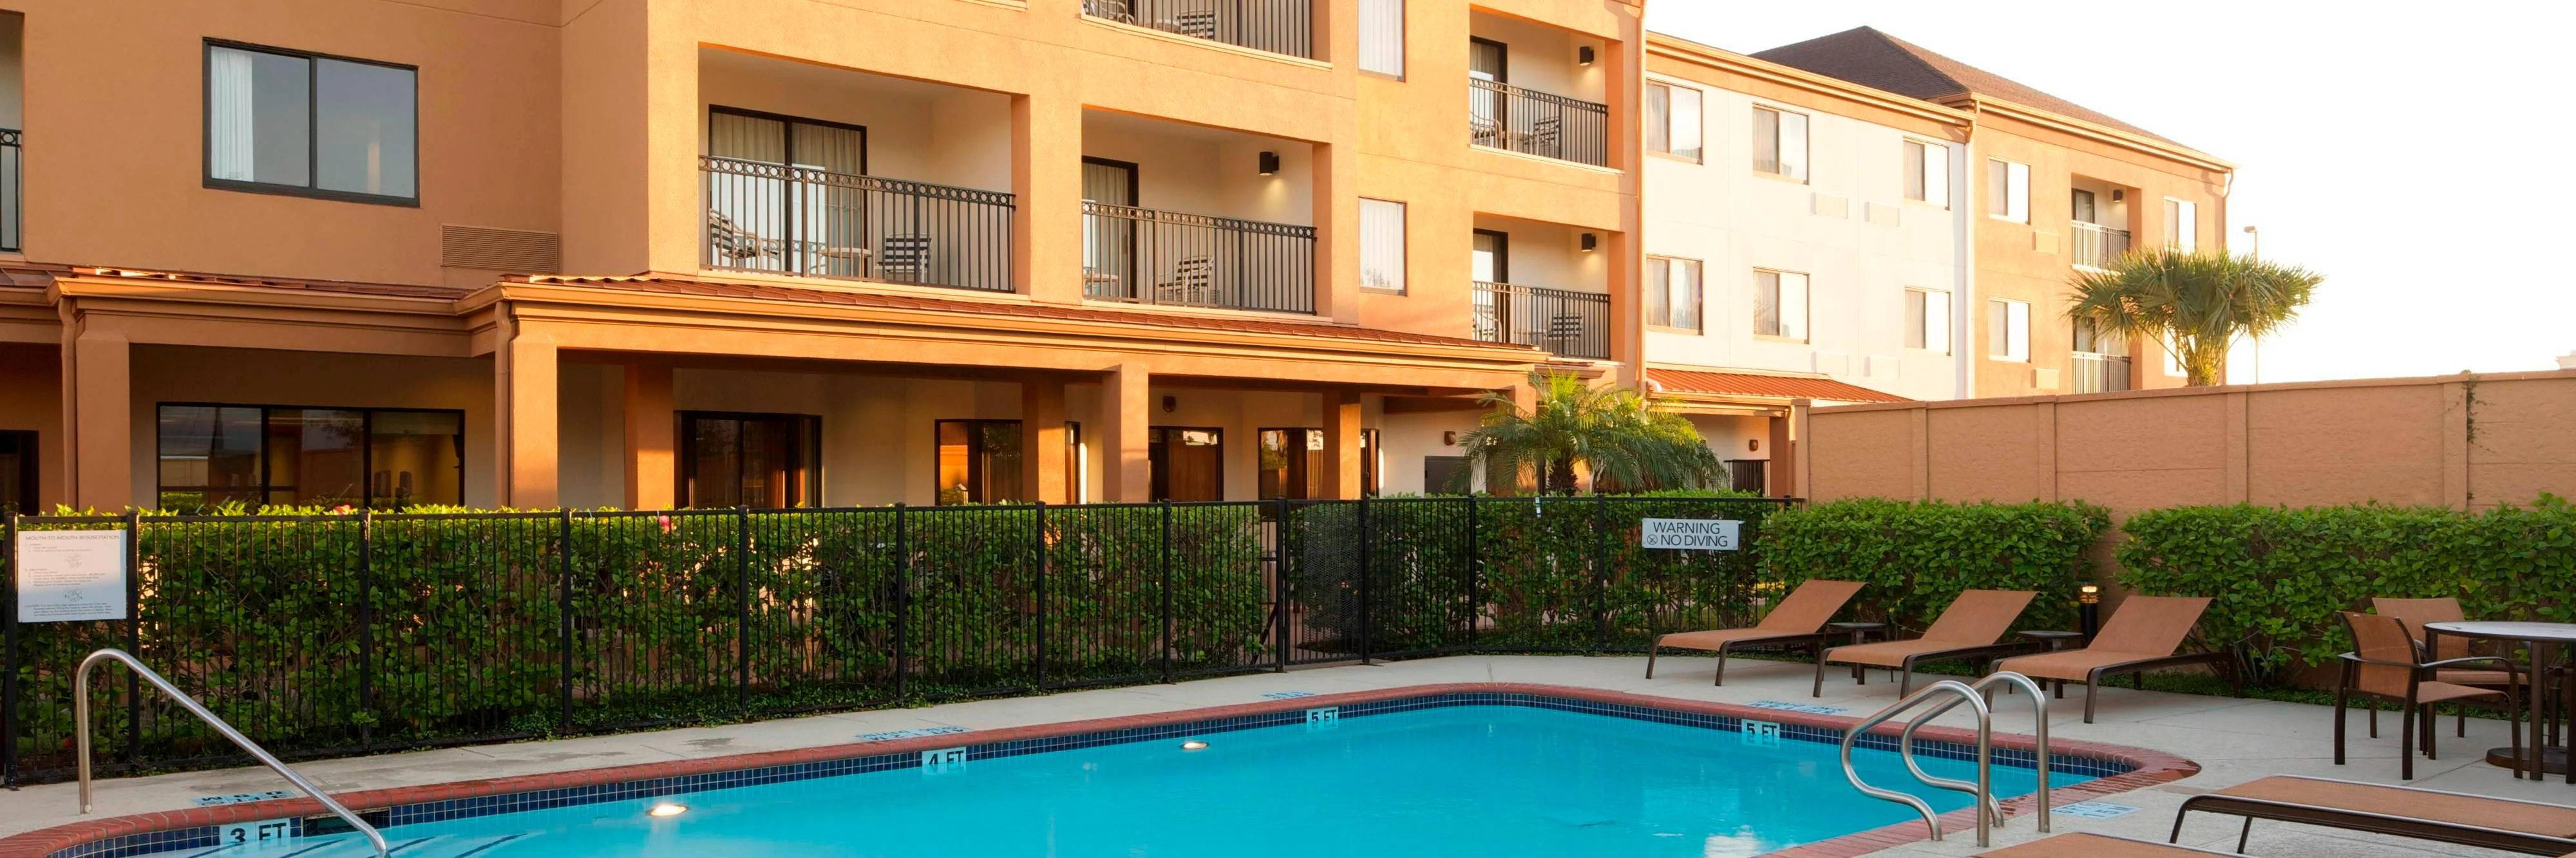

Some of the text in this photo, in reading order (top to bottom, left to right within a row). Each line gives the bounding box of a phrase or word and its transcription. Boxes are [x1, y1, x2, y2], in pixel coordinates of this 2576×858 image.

[1653, 522, 1720, 534] WARNING
[1661, 535, 1728, 546] NO DIVING
[1311, 709, 1337, 722] 5 FT
[1747, 723, 1777, 736] 5 FT
[929, 750, 964, 765] 4 FT
[230, 822, 287, 843] 3 FT
